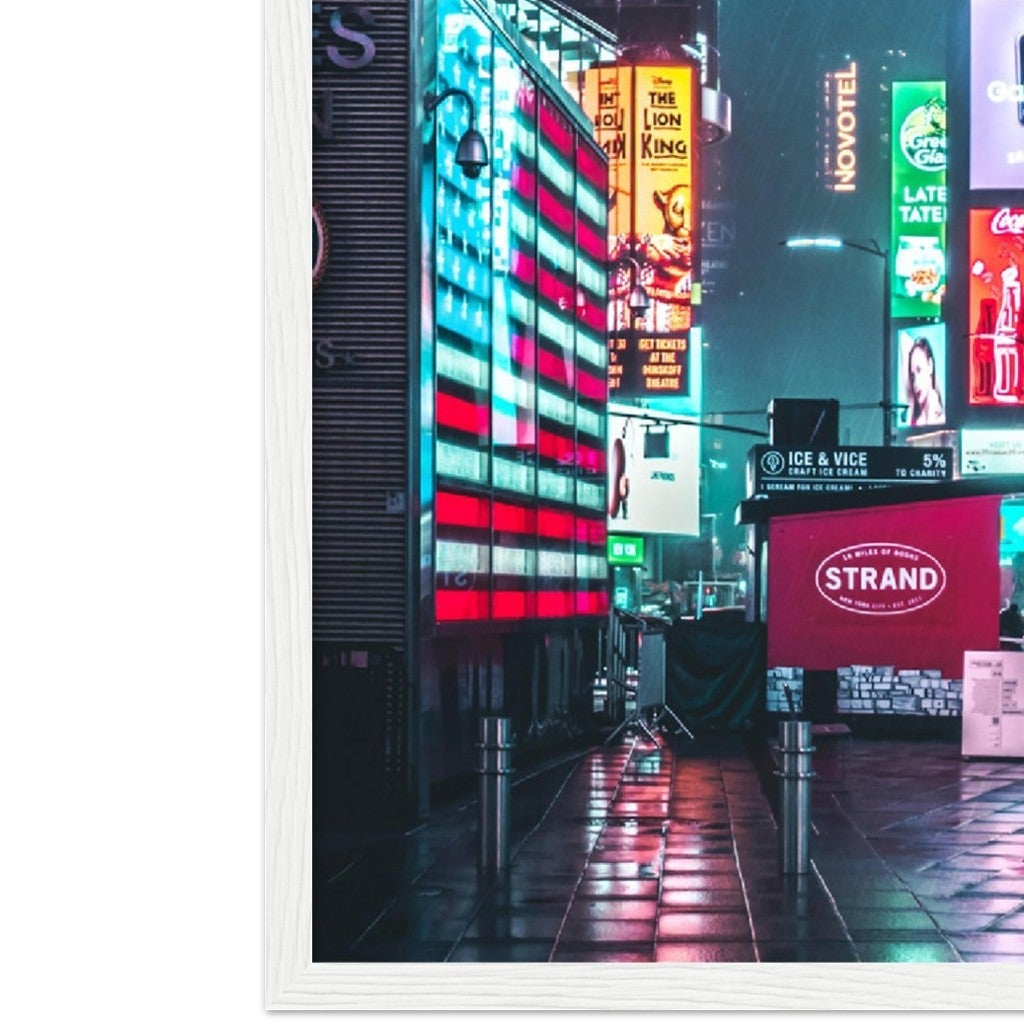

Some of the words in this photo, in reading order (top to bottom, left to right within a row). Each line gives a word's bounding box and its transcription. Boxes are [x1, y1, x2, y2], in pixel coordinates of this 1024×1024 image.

[648, 91, 676, 105] THE
[644, 108, 682, 131] LION
[834, 61, 856, 191] NOVOTEL
[641, 133, 687, 159] KING
[638, 339, 654, 350] GET
[655, 339, 686, 350] TICKETS
[650, 352, 660, 363] AT
[661, 352, 676, 363] THE
[788, 451, 813, 466] ICE
[818, 451, 829, 466] &
[833, 451, 867, 466] VICE
[923, 453, 947, 468] 5%
[788, 467, 817, 476] CRAFT
[819, 468, 834, 476] ICE
[836, 468, 868, 476] CREAM
[896, 468, 906, 477] TO
[910, 468, 947, 477] CHARITY
[767, 483, 795, 491] SCREAM
[797, 483, 811, 491] FOR
[855, 549, 878, 558] MILES
[893, 550, 919, 562] BOOKS
[825, 567, 938, 590] STRAND
